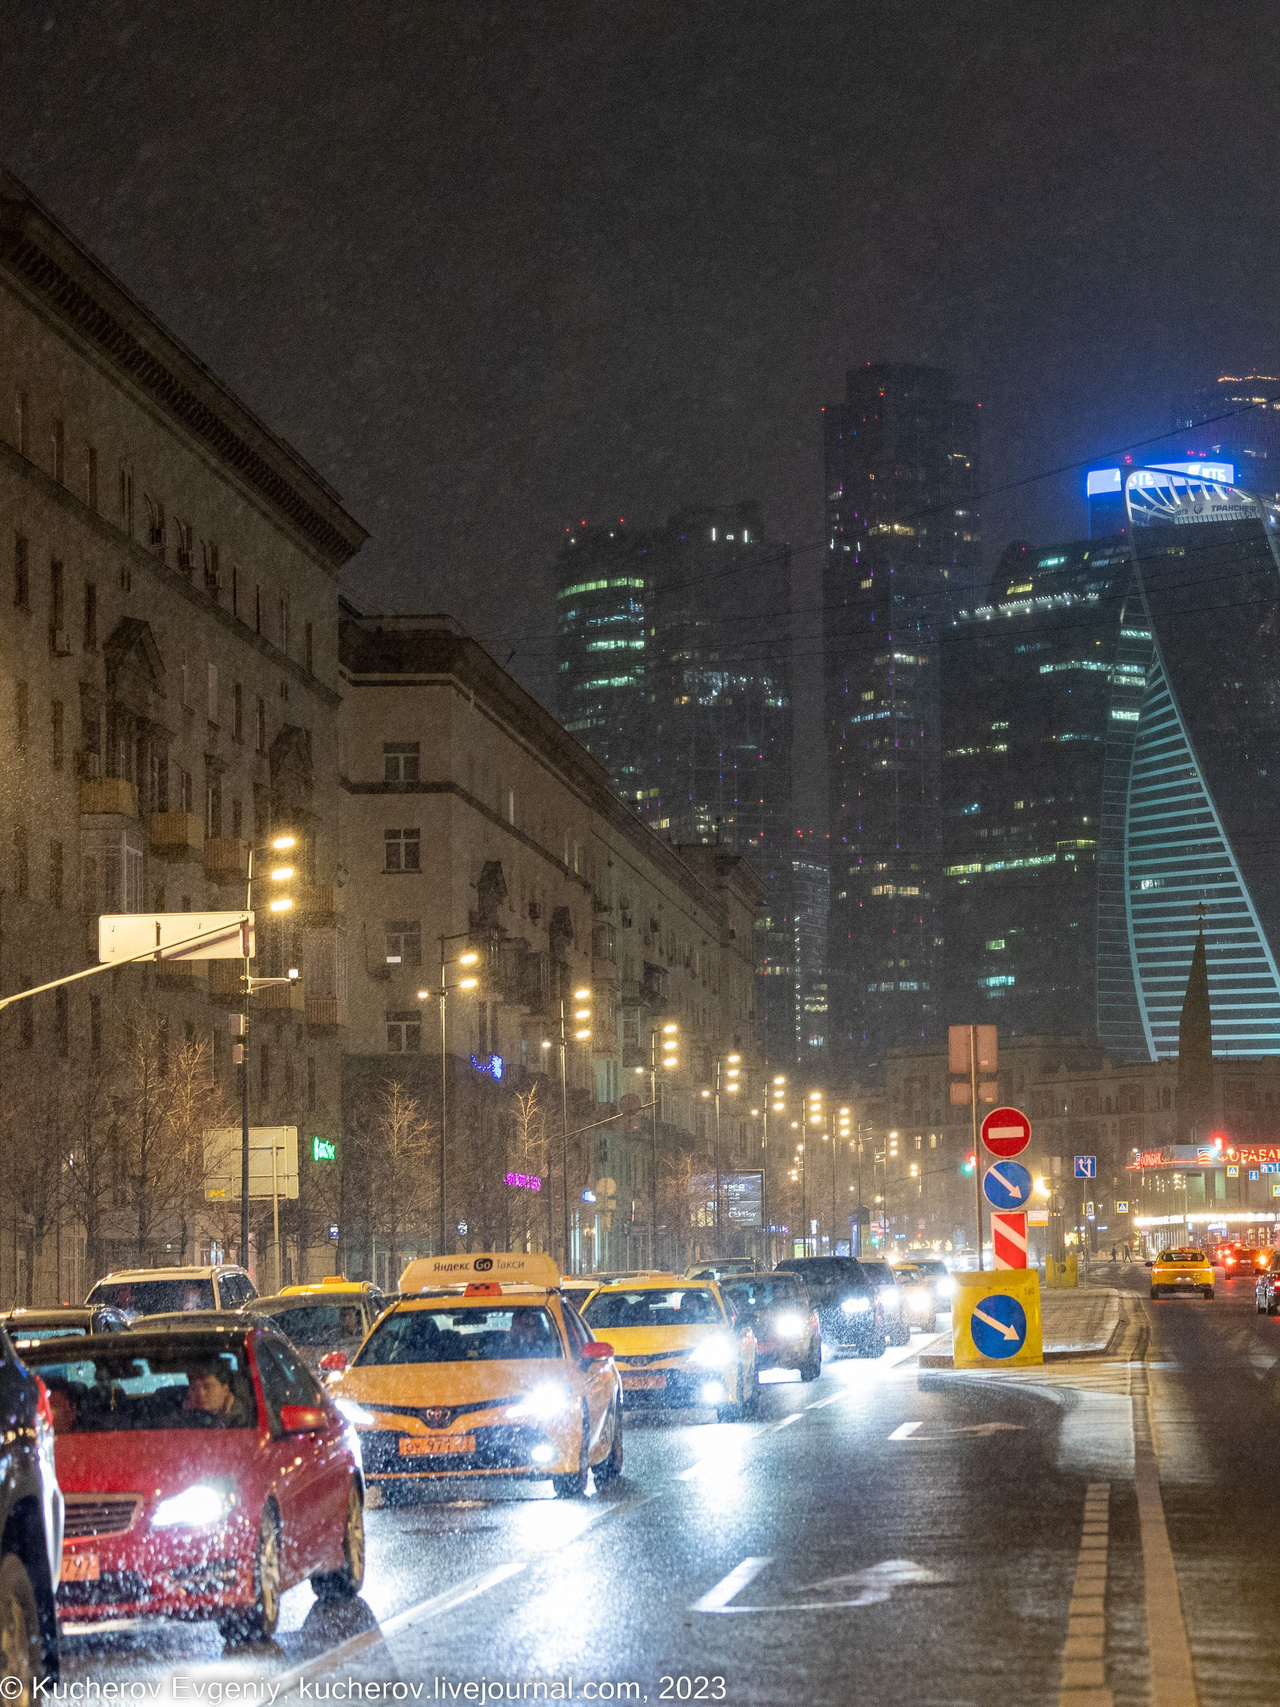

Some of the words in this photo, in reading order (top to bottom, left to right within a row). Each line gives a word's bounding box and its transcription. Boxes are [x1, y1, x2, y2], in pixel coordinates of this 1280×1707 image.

[433, 1261, 471, 1272] Яндекс
[475, 1259, 492, 1271] Go
[496, 1259, 525, 1270] Такси
